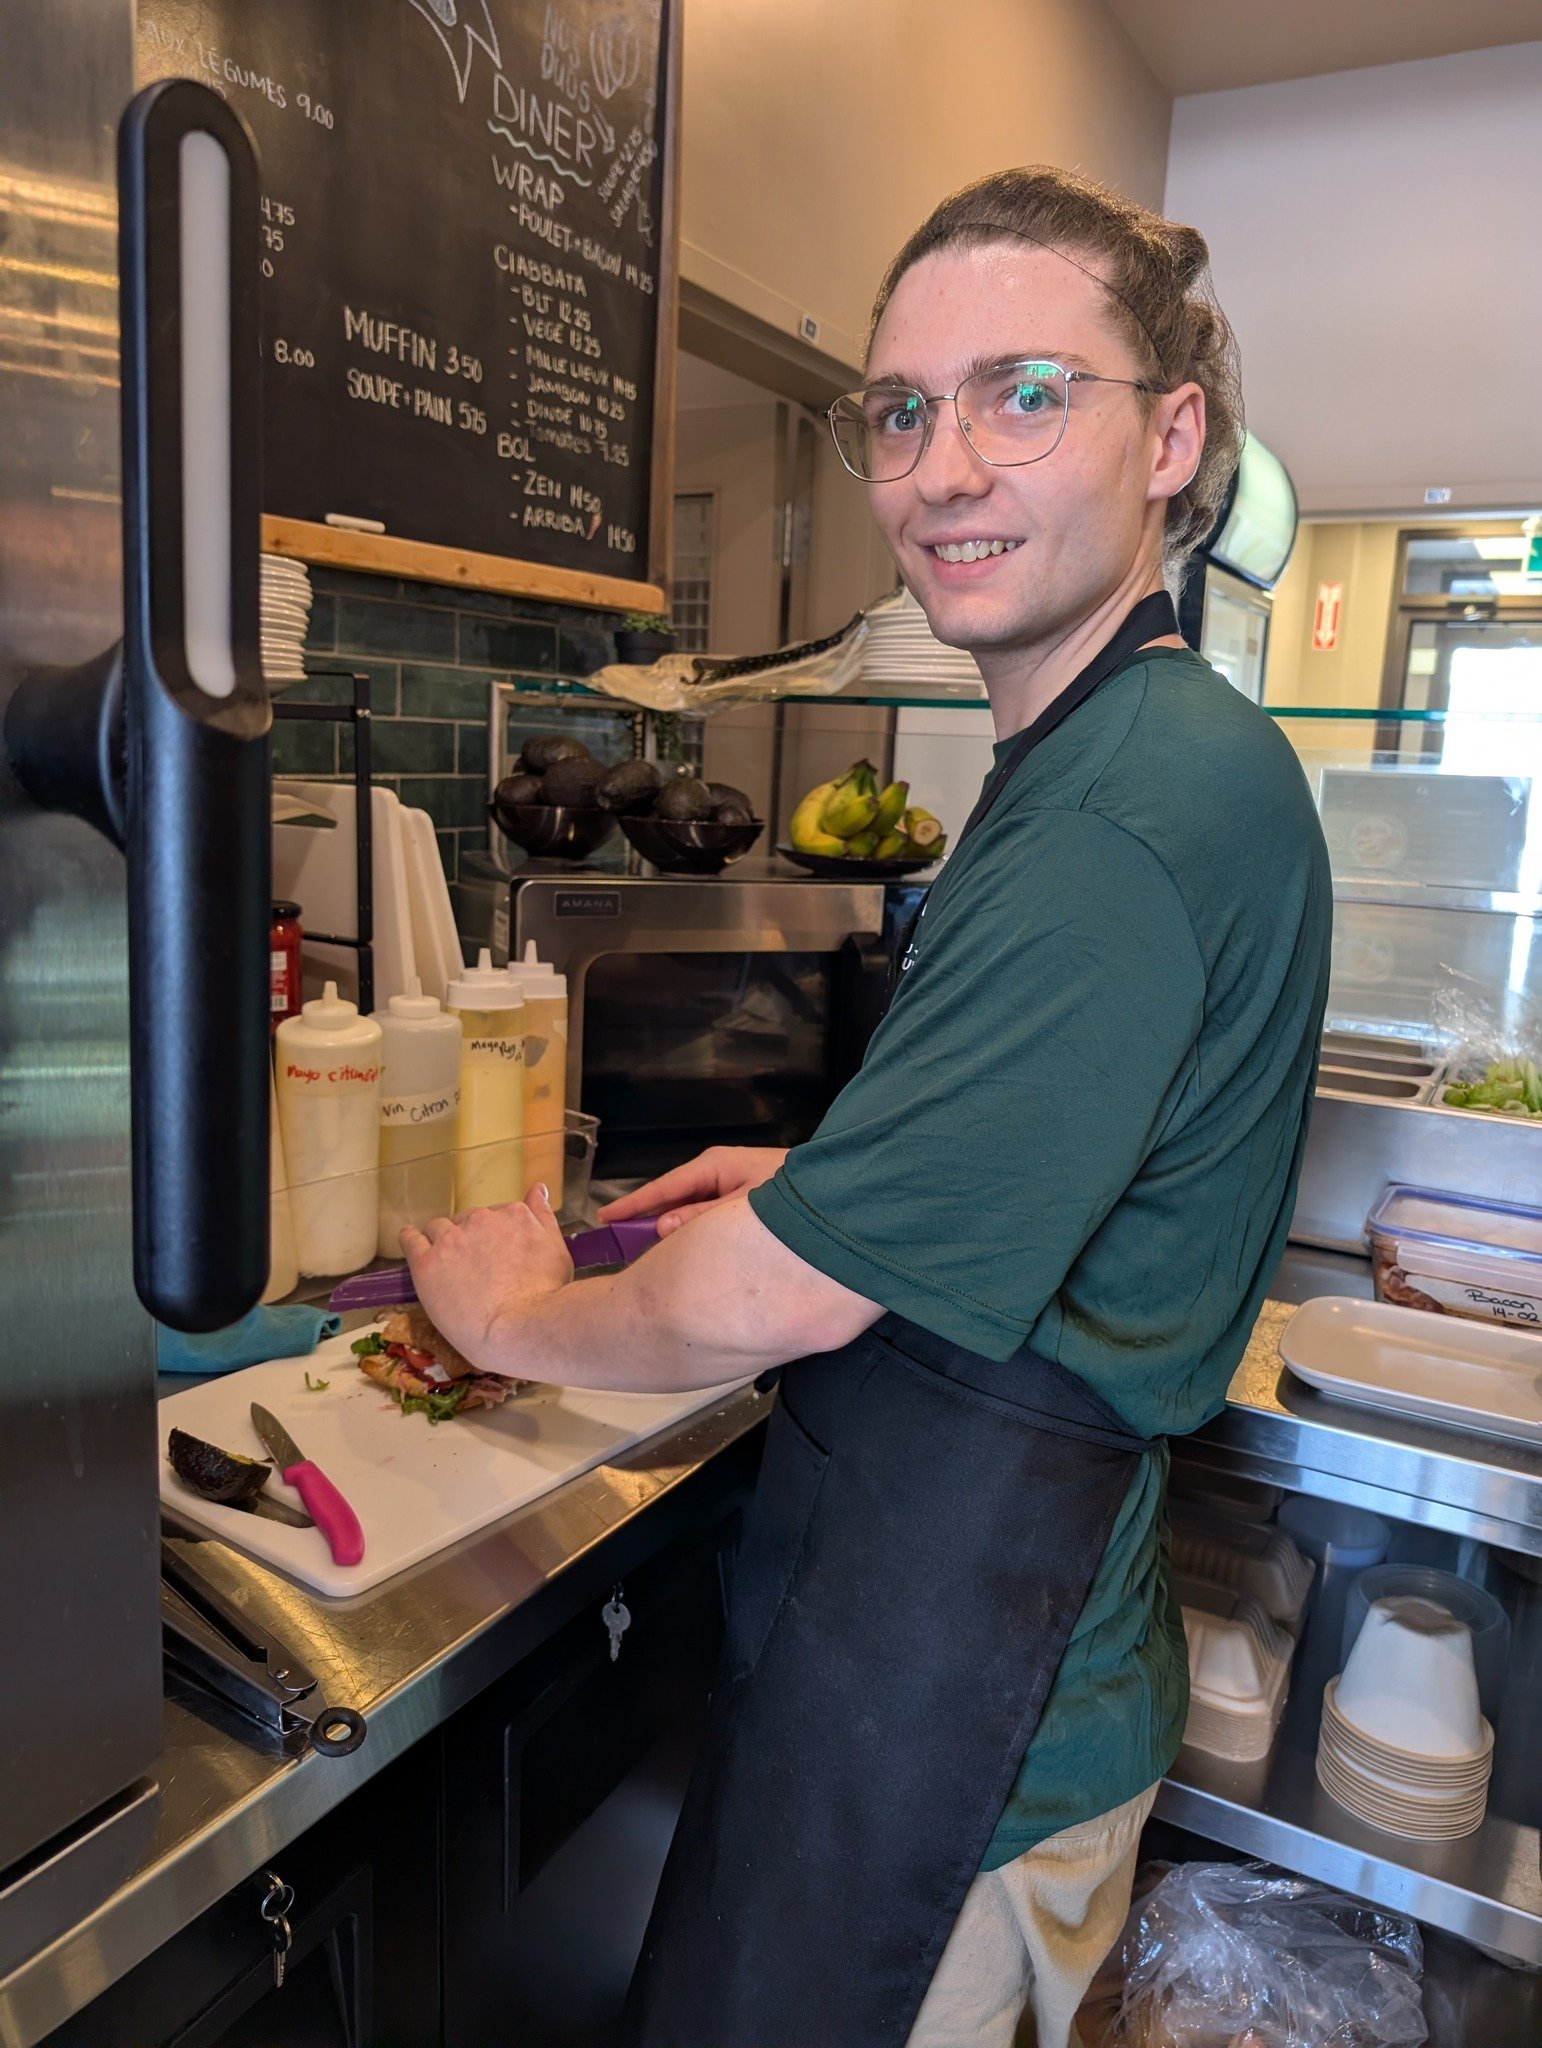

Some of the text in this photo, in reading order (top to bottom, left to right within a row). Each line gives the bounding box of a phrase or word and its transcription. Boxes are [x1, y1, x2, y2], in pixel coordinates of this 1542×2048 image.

[493, 73, 596, 169] DINER
[491, 154, 565, 211] WRAP
[522, 284, 554, 315] BLT
[273, 338, 315, 368] 8.00
[343, 305, 437, 372] MUFFIN
[346, 367, 403, 408] SOUPE
[413, 388, 453, 426] PAIN
[497, 432, 536, 463] BOL
[523, 469, 562, 499] ZEN
[561, 898, 614, 909] AMANA
[409, 1098, 449, 1122] Citron
[1464, 1288, 1535, 1311] Bacon
